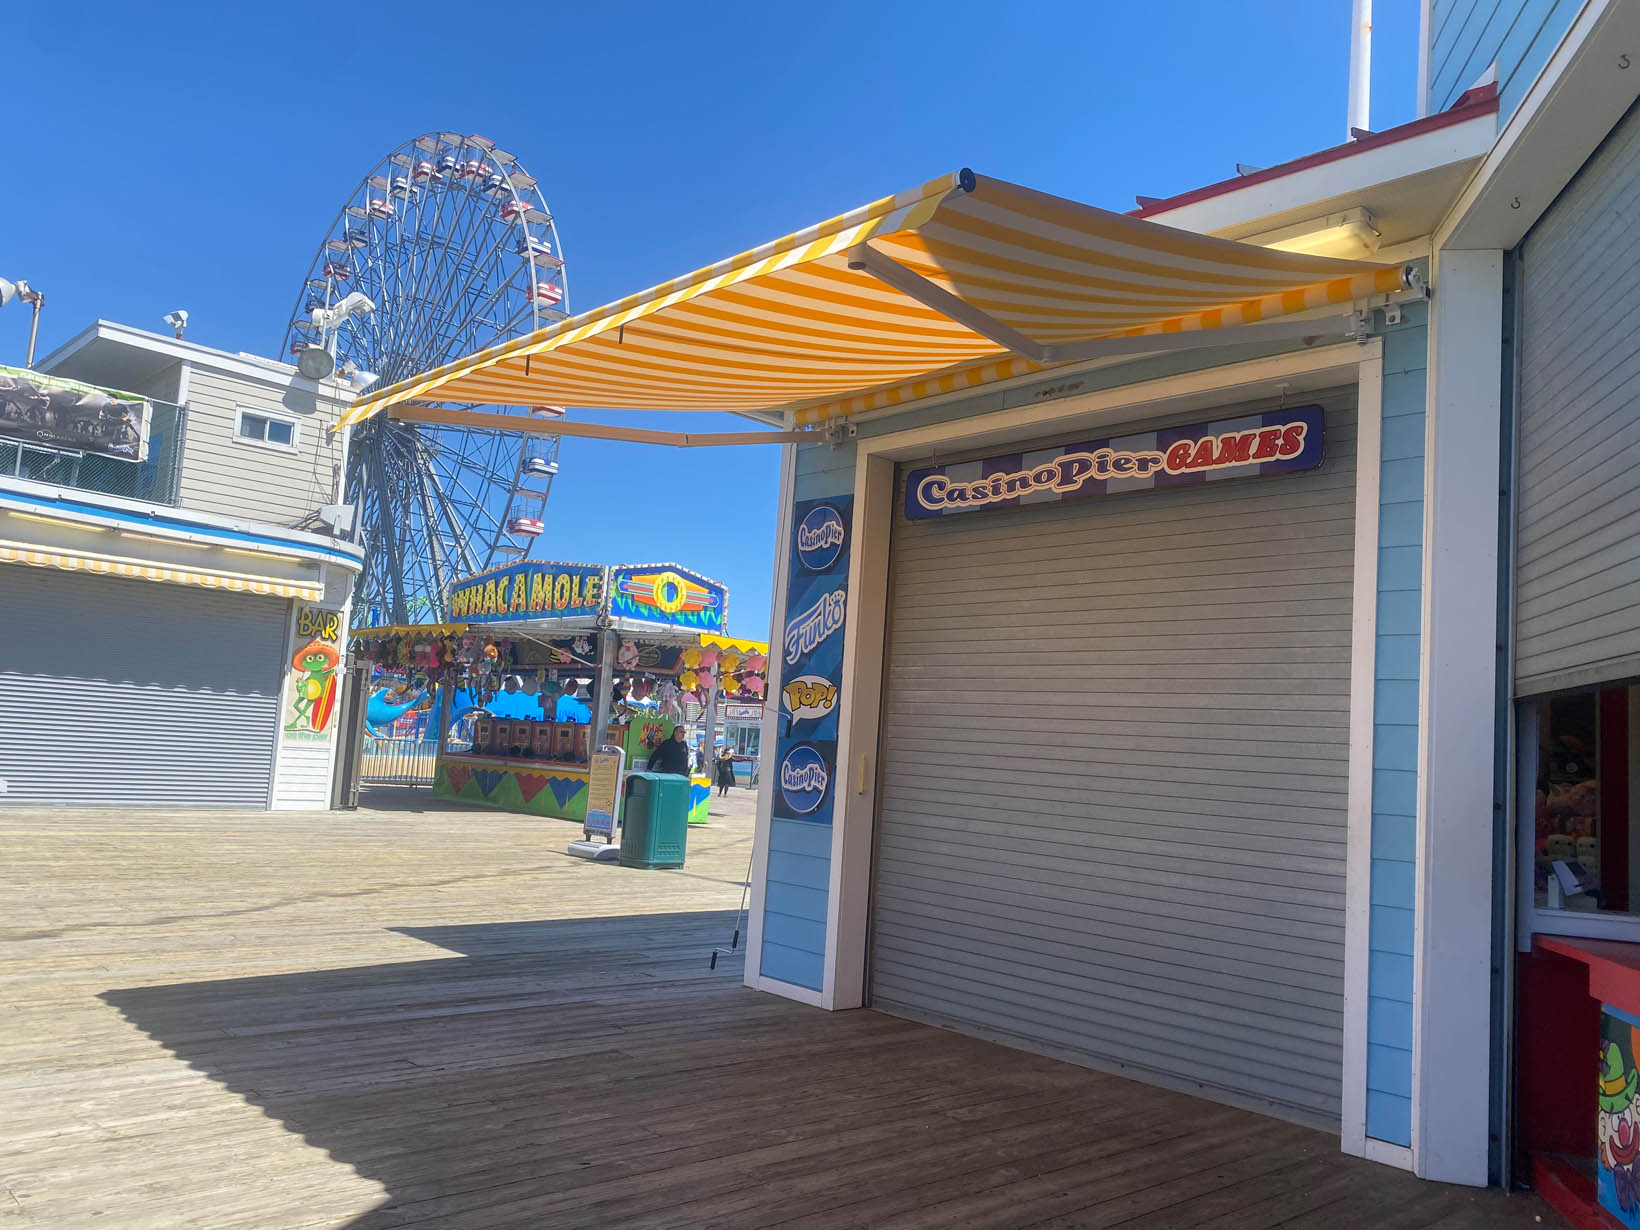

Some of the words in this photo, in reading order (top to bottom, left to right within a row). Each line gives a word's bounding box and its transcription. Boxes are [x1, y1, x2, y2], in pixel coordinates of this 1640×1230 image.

[1166, 424, 1305, 472] GAMES
[299, 608, 339, 642] BAR
[785, 590, 845, 664] Funko
